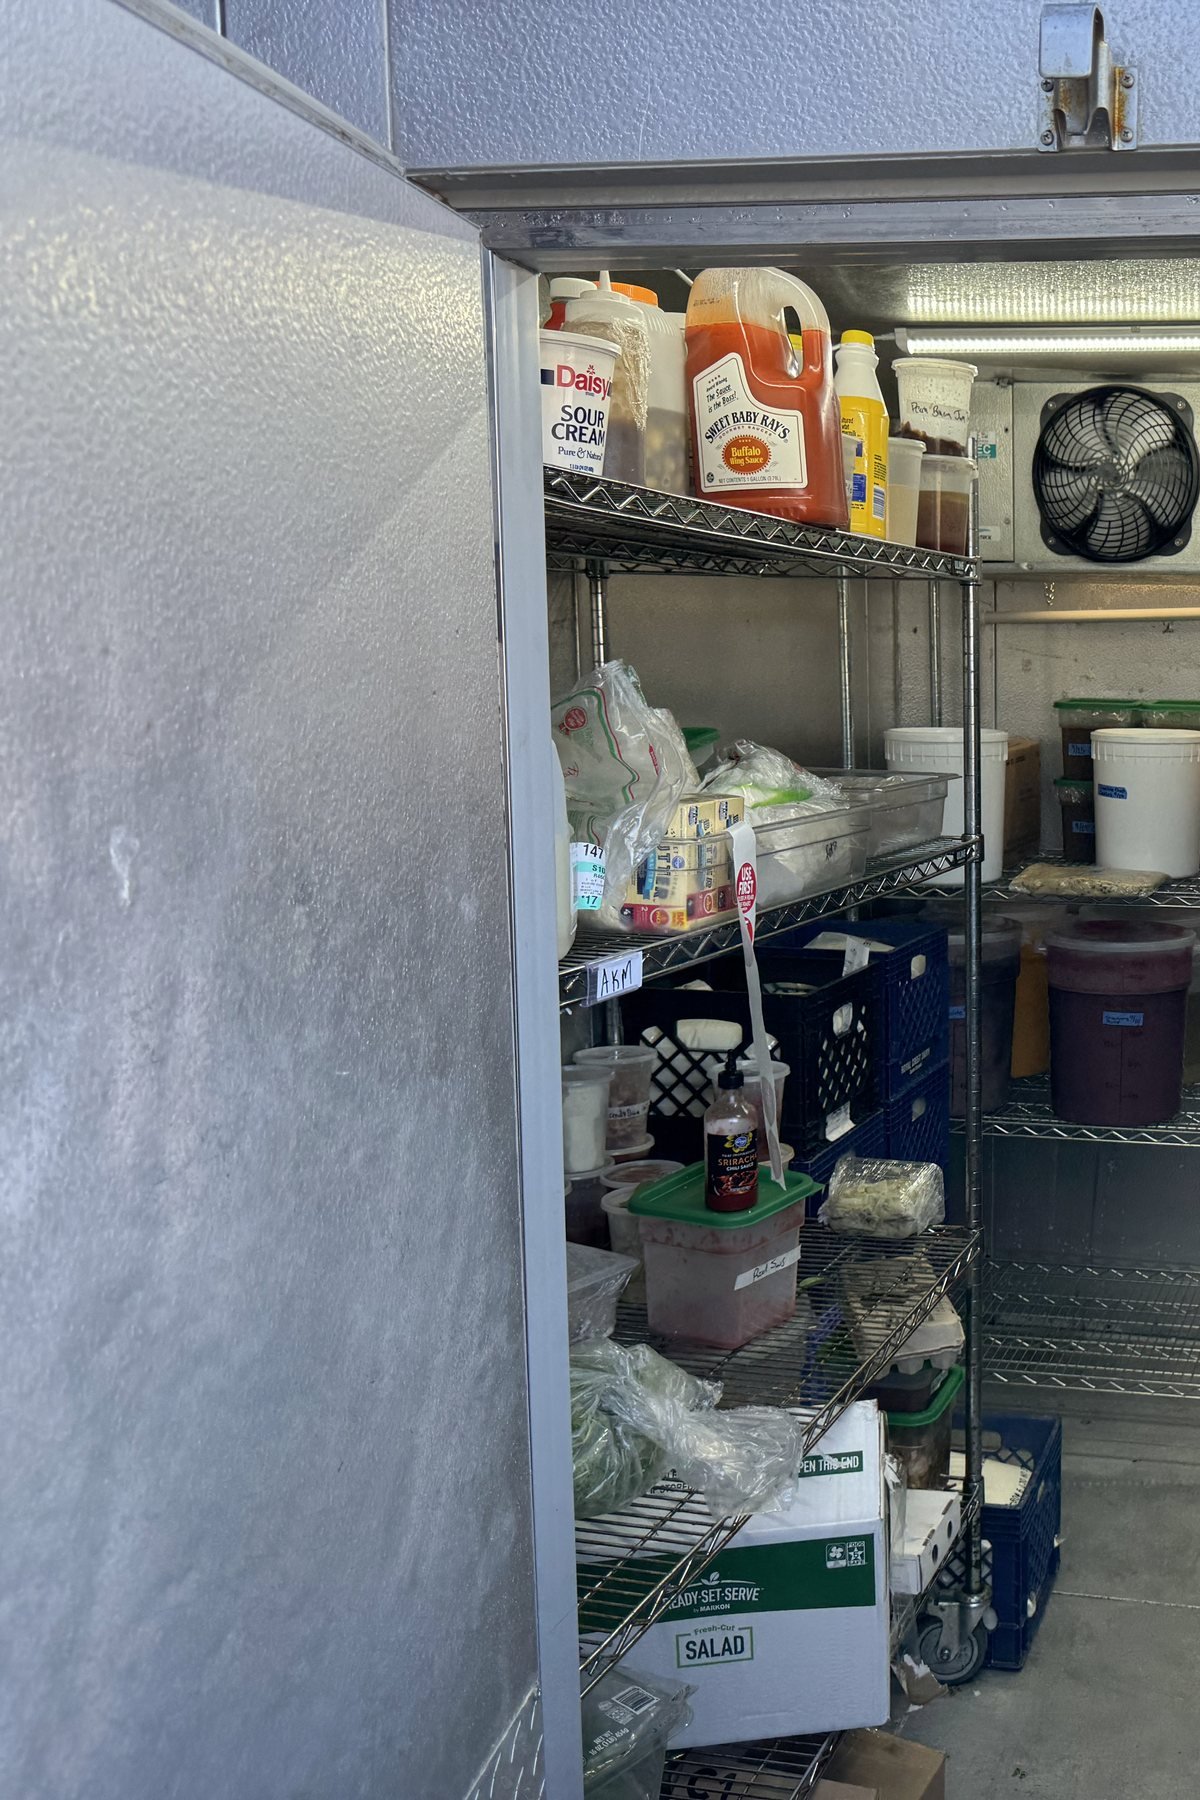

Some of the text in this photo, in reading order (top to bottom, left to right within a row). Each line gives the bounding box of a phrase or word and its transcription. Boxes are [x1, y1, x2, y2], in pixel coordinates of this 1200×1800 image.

[556, 364, 608, 400] Daisy
[706, 384, 732, 402] The Sauce
[714, 400, 722, 410] the
[722, 391, 737, 405] Boss!
[560, 405, 605, 428] SOUR
[552, 423, 606, 447] CREAM
[704, 410, 790, 444] SWEET BABY RAY'S
[558, 446, 576, 456] Pure
[577, 447, 586, 458] &
[731, 446, 761, 456] Buffalo
[730, 456, 764, 466] Wing Sauce
[584, 844, 604, 859] 147
[742, 866, 752, 880] USE
[738, 880, 754, 896] FIRST
[600, 960, 632, 996] AKM
[740, 1162, 754, 1170] SAUCE
[798, 1459, 816, 1474] PEN
[839, 1455, 860, 1469] END
[700, 1604, 730, 1612] MARKON
[694, 1624, 736, 1636] Fresh-Cut
[686, 1635, 744, 1660] SALAD
